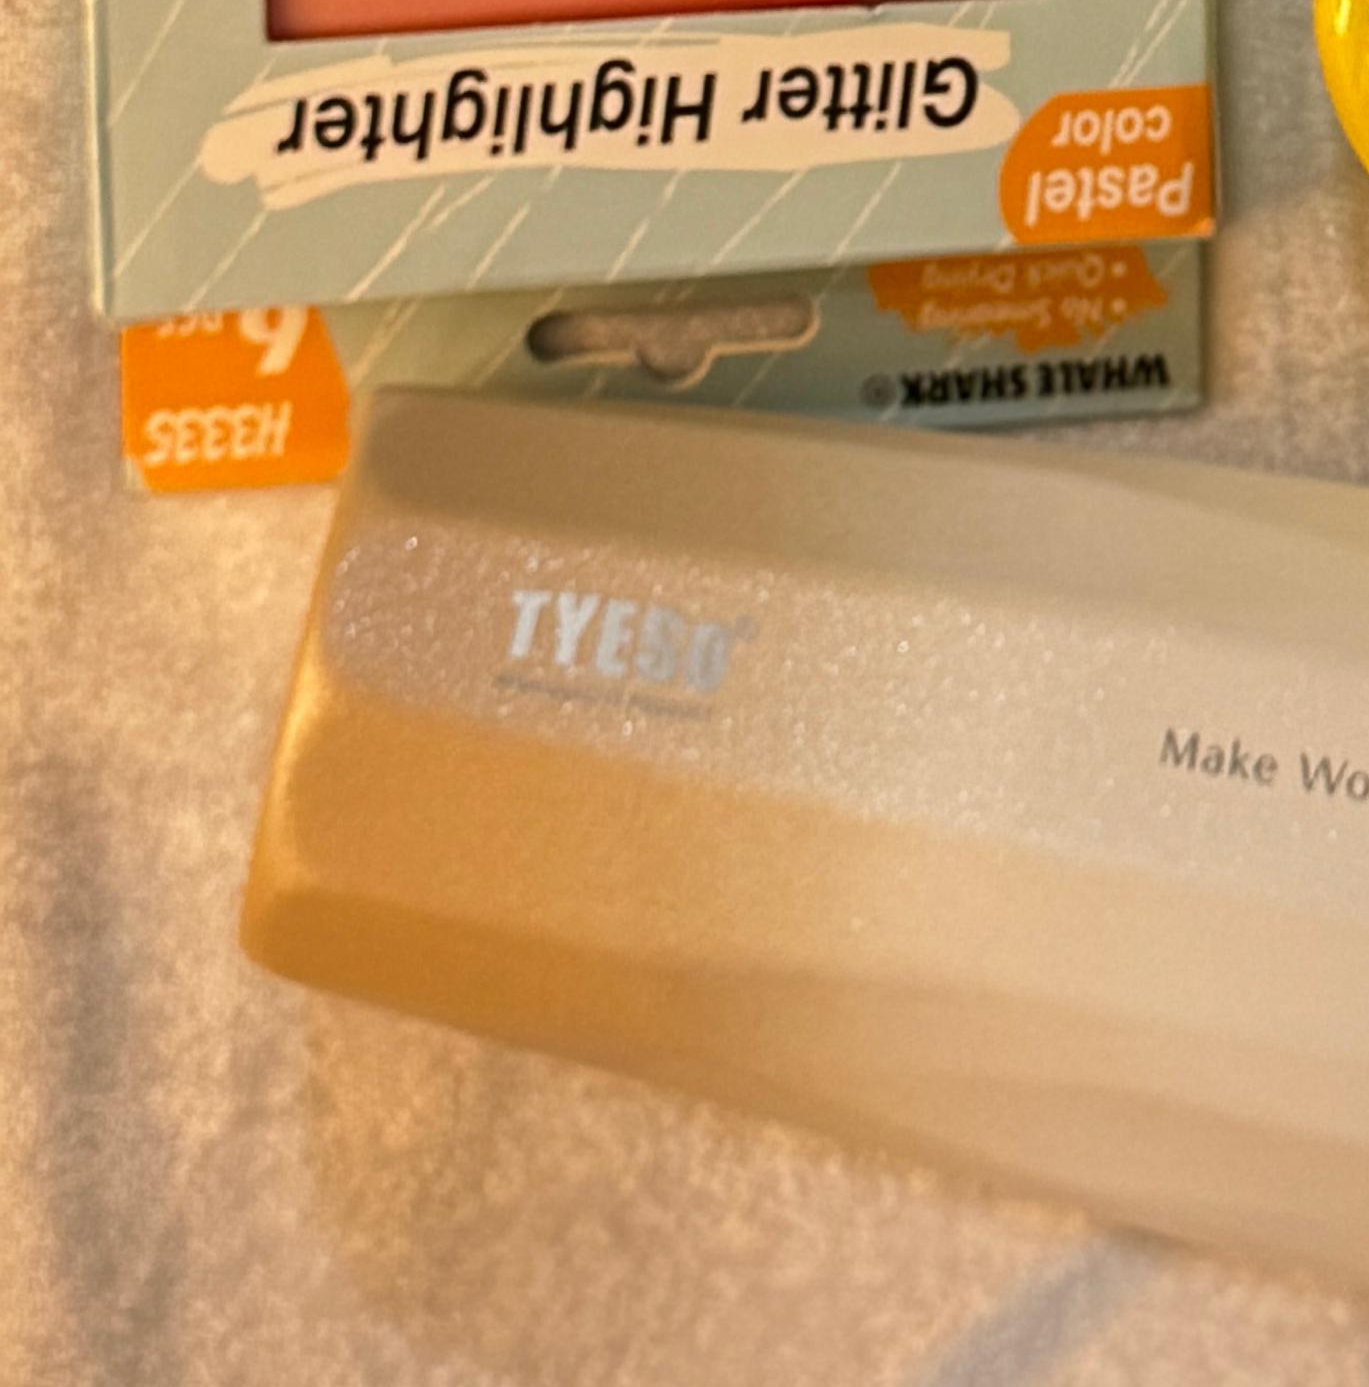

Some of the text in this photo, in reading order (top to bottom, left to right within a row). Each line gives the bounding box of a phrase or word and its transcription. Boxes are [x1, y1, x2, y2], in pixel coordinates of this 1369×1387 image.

[276, 55, 980, 163] Glitter Highlighter
[1051, 104, 1173, 155] color
[1024, 161, 1194, 228] Pastel
[239, 306, 308, 378] 6
[901, 353, 1171, 408] WHALE SHARK
[144, 401, 292, 467] H3335
[508, 589, 731, 693] TYESO
[1159, 727, 1279, 785] Make
